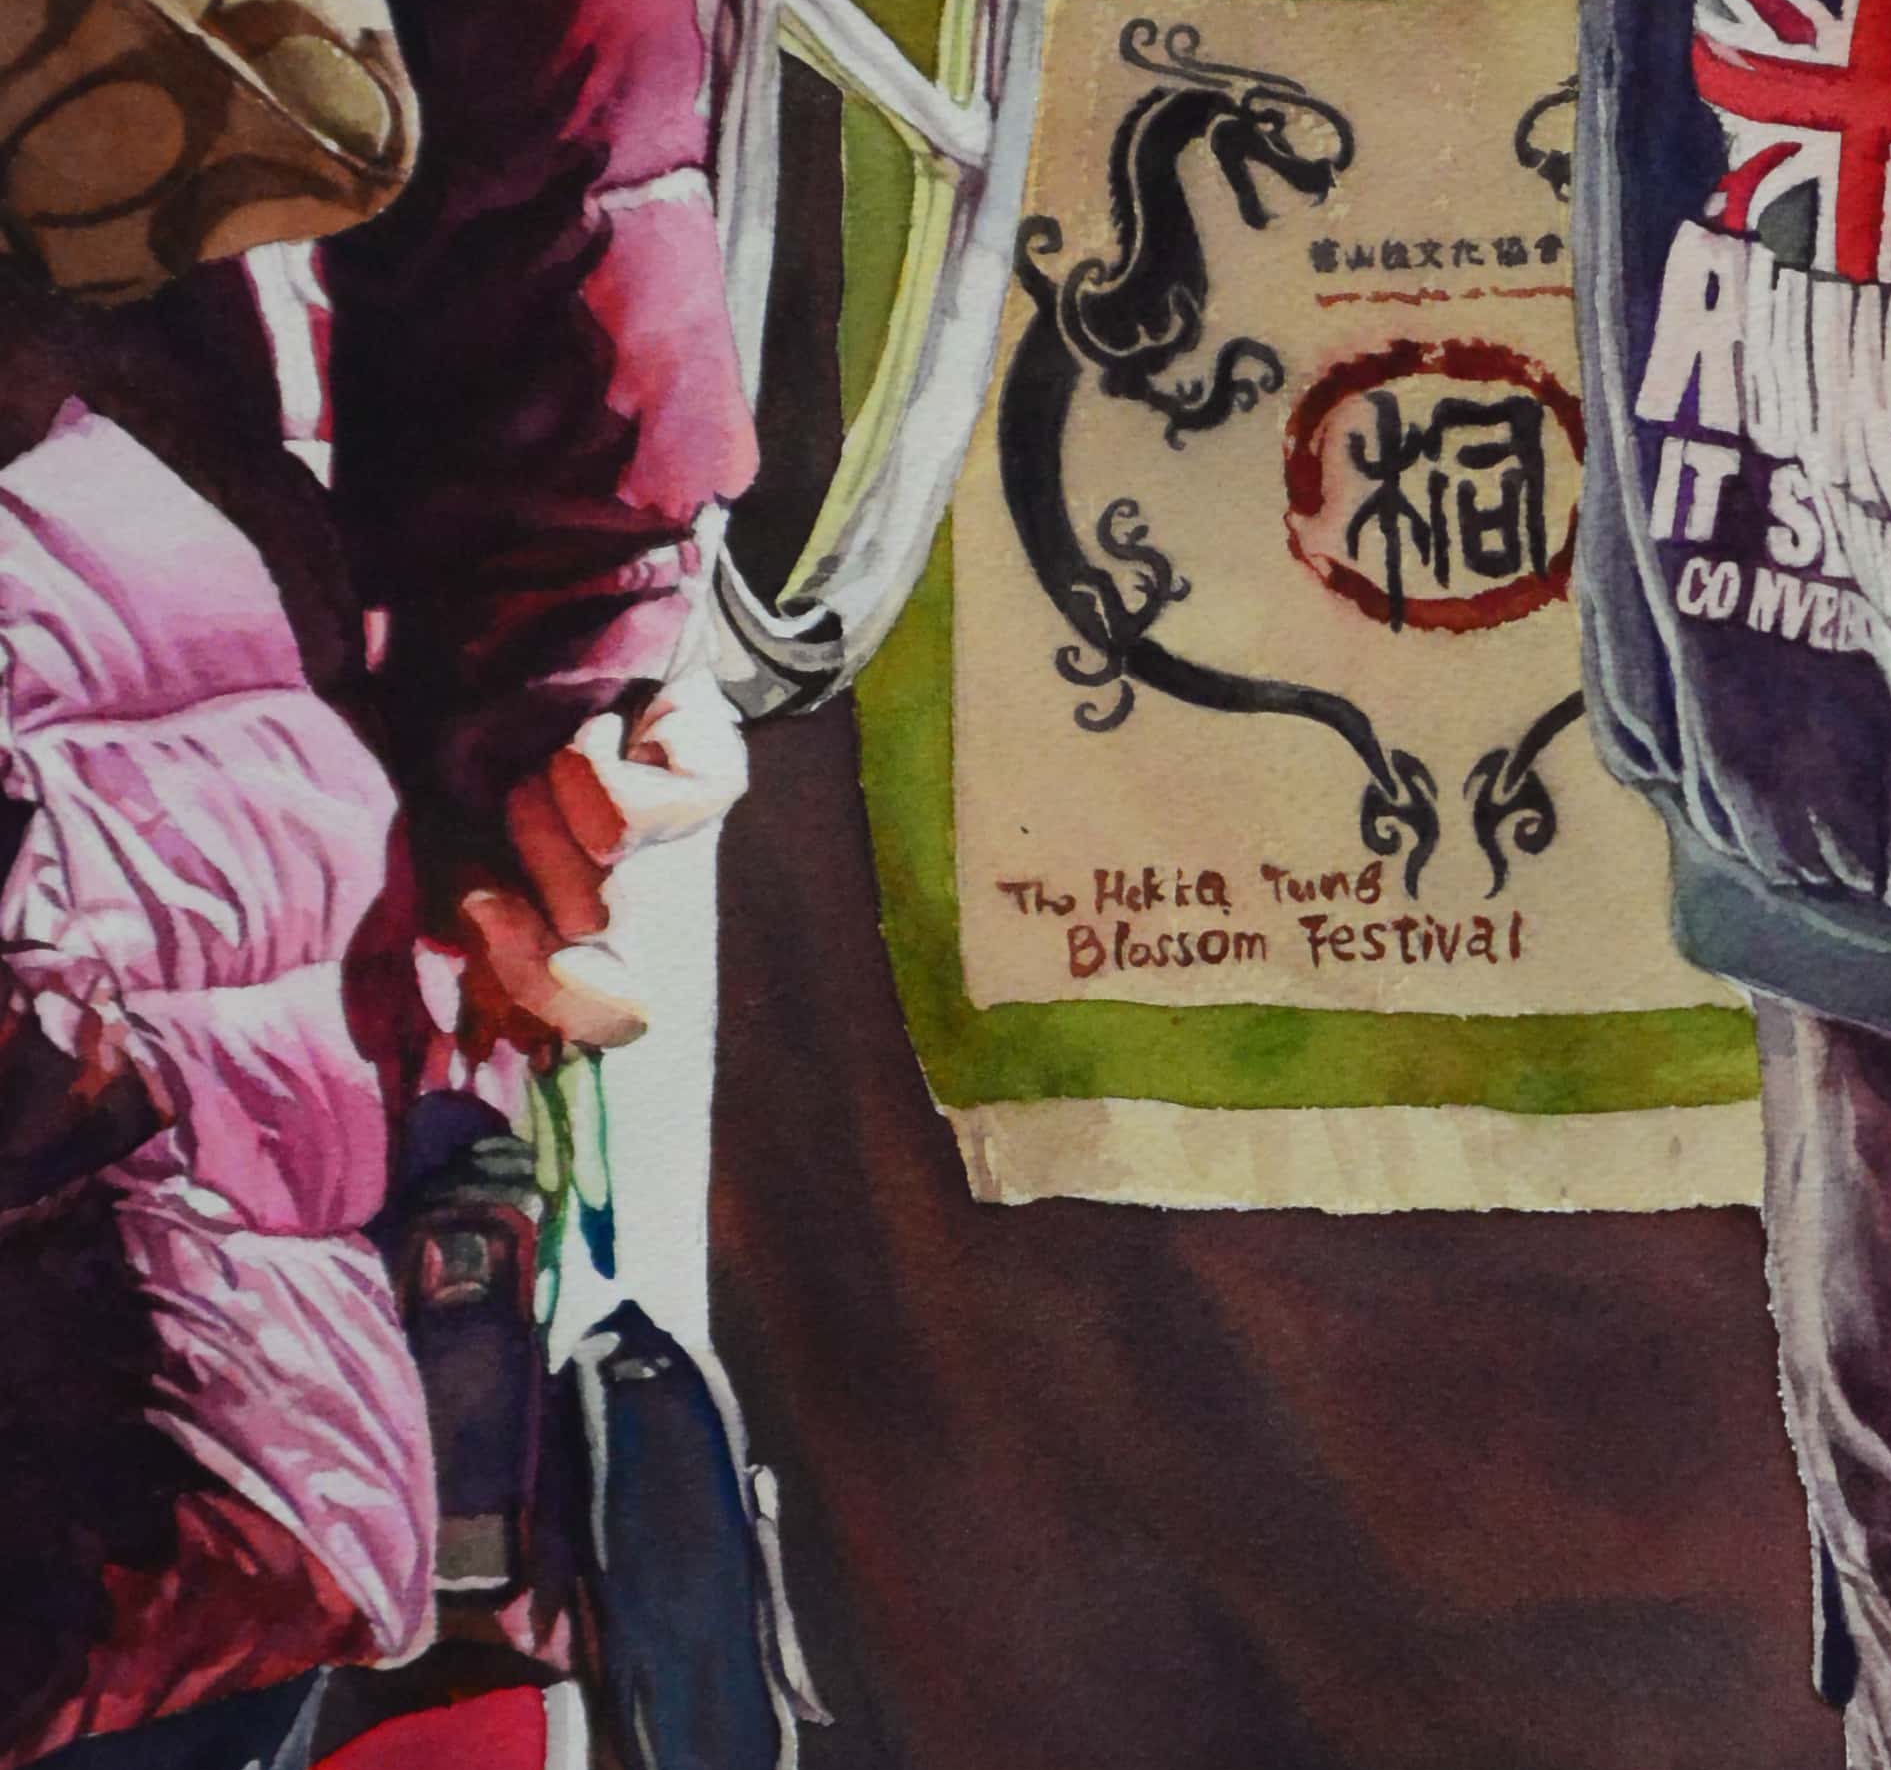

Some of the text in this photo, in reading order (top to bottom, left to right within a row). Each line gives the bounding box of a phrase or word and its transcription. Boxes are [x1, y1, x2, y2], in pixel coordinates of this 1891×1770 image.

[1650, 436, 1741, 542] IT
[1067, 910, 1523, 978] Blossom Festival
